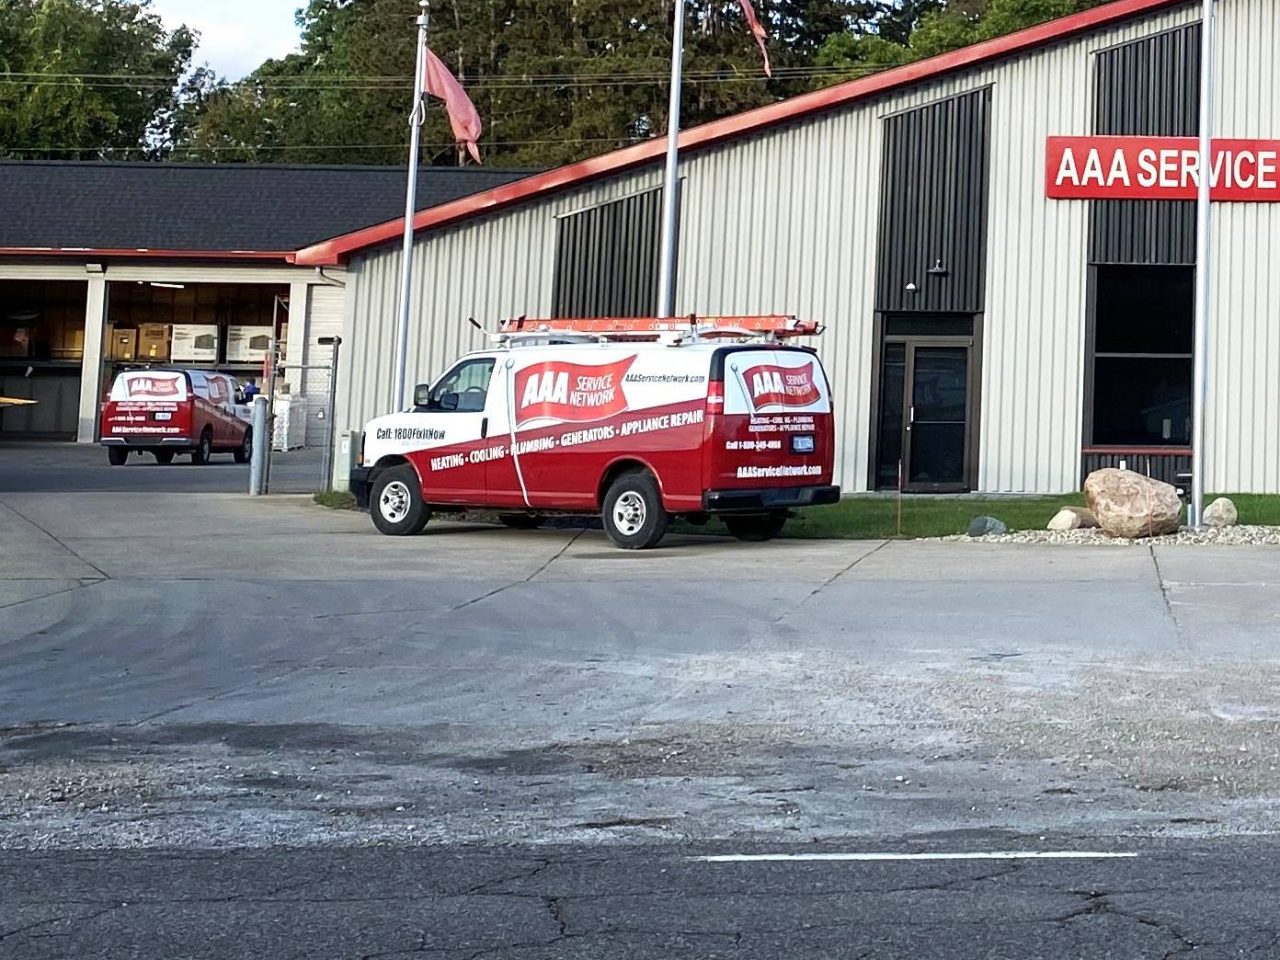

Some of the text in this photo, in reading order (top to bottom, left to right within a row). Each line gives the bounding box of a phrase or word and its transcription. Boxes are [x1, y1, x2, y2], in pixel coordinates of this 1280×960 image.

[1055, 147, 1132, 187] AAA
[1136, 148, 1277, 189] SERVICE
[131, 379, 152, 392] AAA
[576, 373, 613, 390] SERVICE
[625, 373, 705, 383] AAAServiceNetwork.com
[752, 371, 785, 397] AAA
[521, 371, 569, 408] AAA
[570, 388, 615, 406] NETWORK
[431, 410, 704, 471] HEATING COOLING PLUMBING GENERATORS APPLIANCE REPAIR
